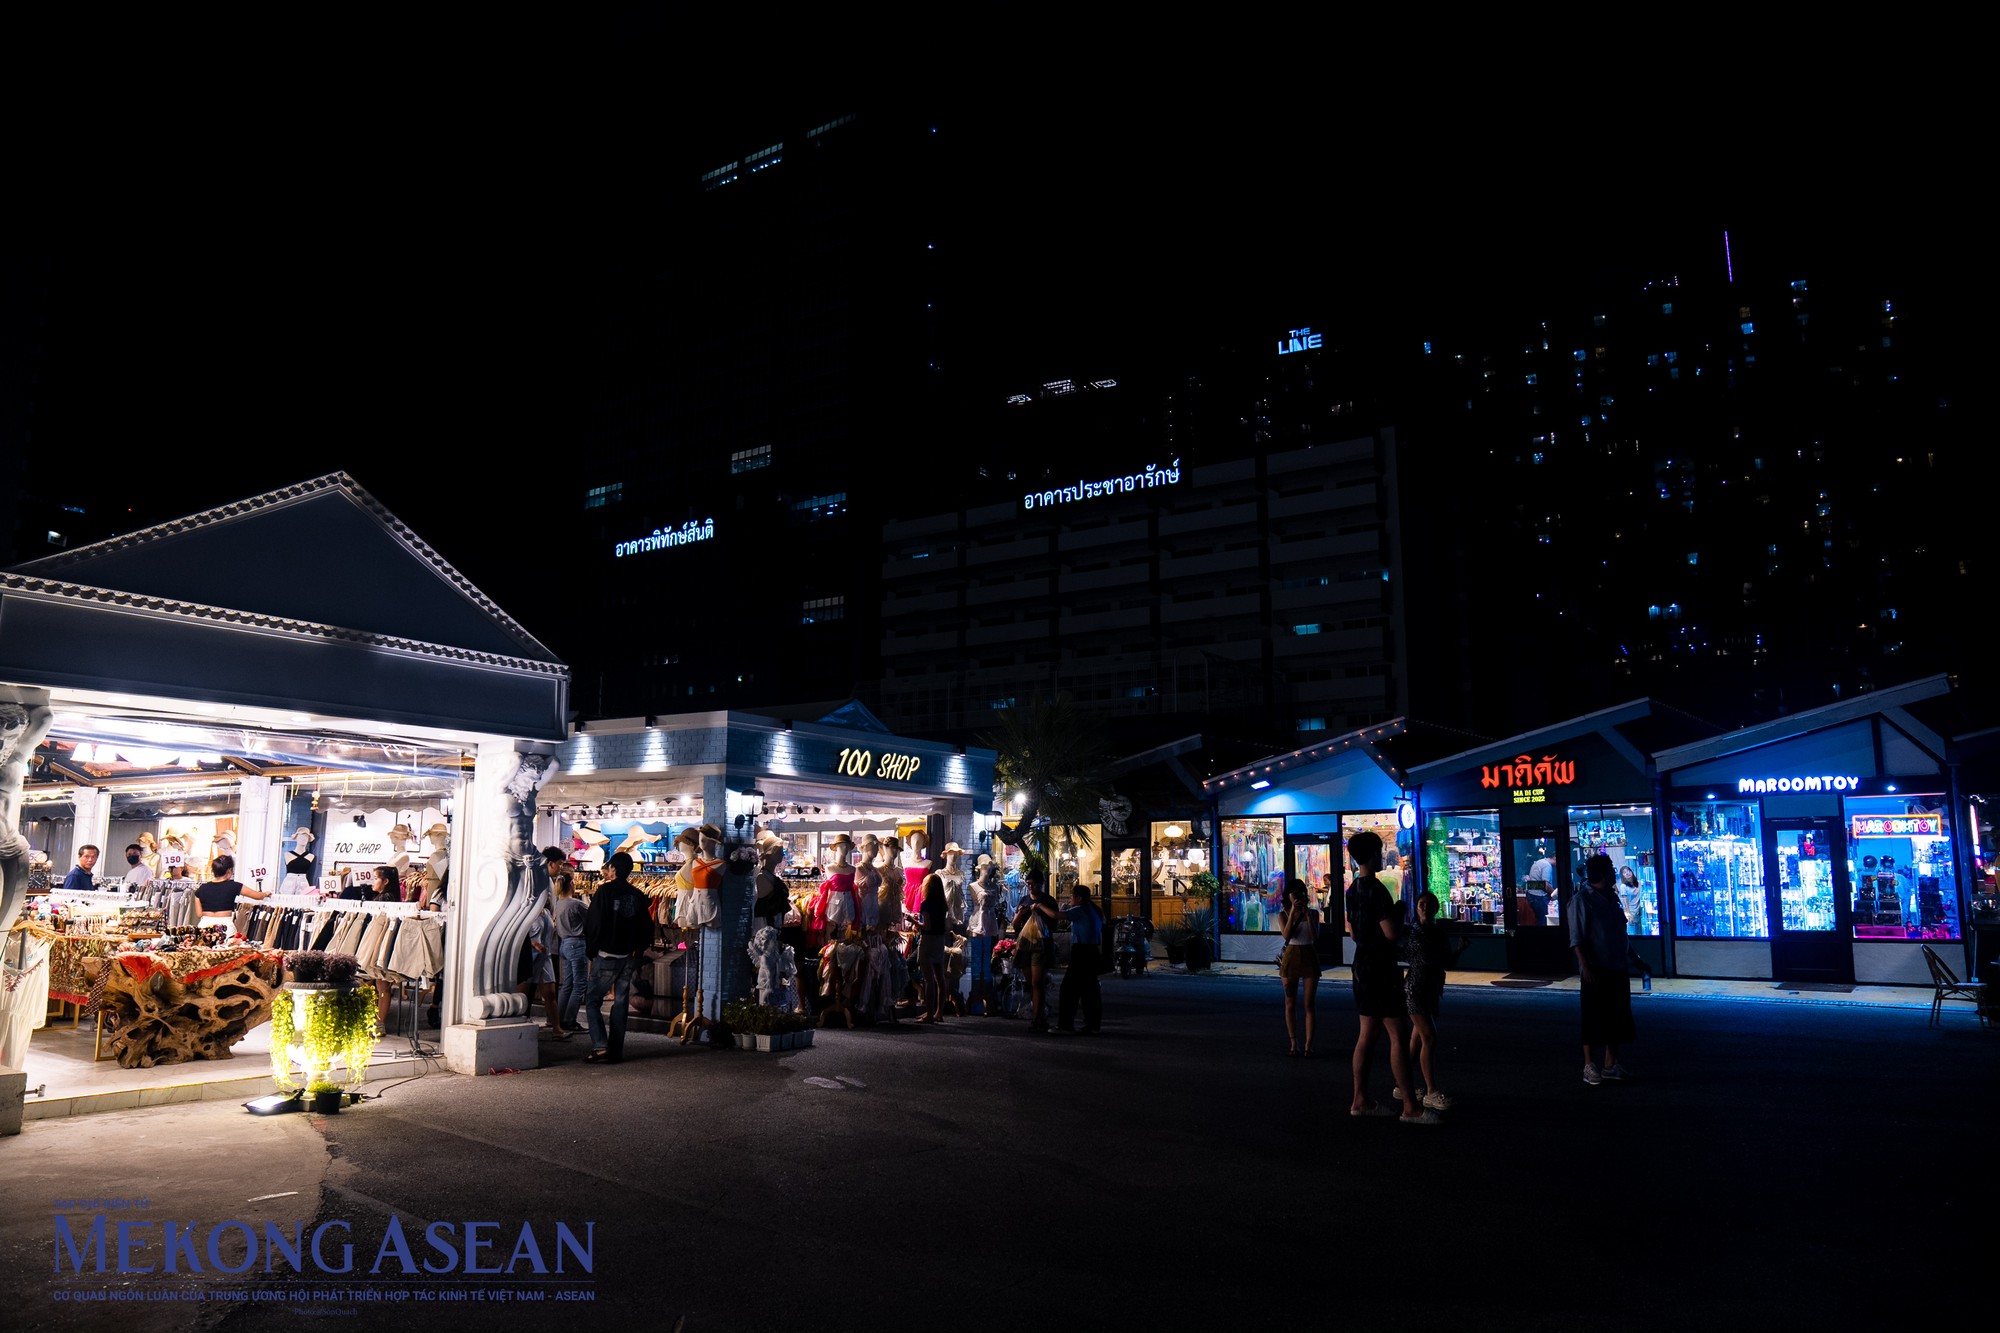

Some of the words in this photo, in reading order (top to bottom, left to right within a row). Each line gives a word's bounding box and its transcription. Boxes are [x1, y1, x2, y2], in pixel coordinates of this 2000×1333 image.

[1289, 327, 1310, 338] THE
[1278, 333, 1322, 355] LINE
[1024, 458, 1180, 509] อาคารประชาอารักษ์
[616, 518, 714, 557] อาคารพิทักษ์สันติ
[838, 748, 871, 777] 100
[877, 752, 920, 781] SHOP
[1738, 775, 1859, 794] MAROOMTOY
[1856, 818, 1940, 834] MAROOMTOY
[335, 842, 353, 854] 100
[356, 843, 382, 854] SHOP
[165, 855, 181, 864] 150
[250, 867, 267, 878] 150
[355, 871, 371, 881] 150
[324, 879, 337, 890] 80
